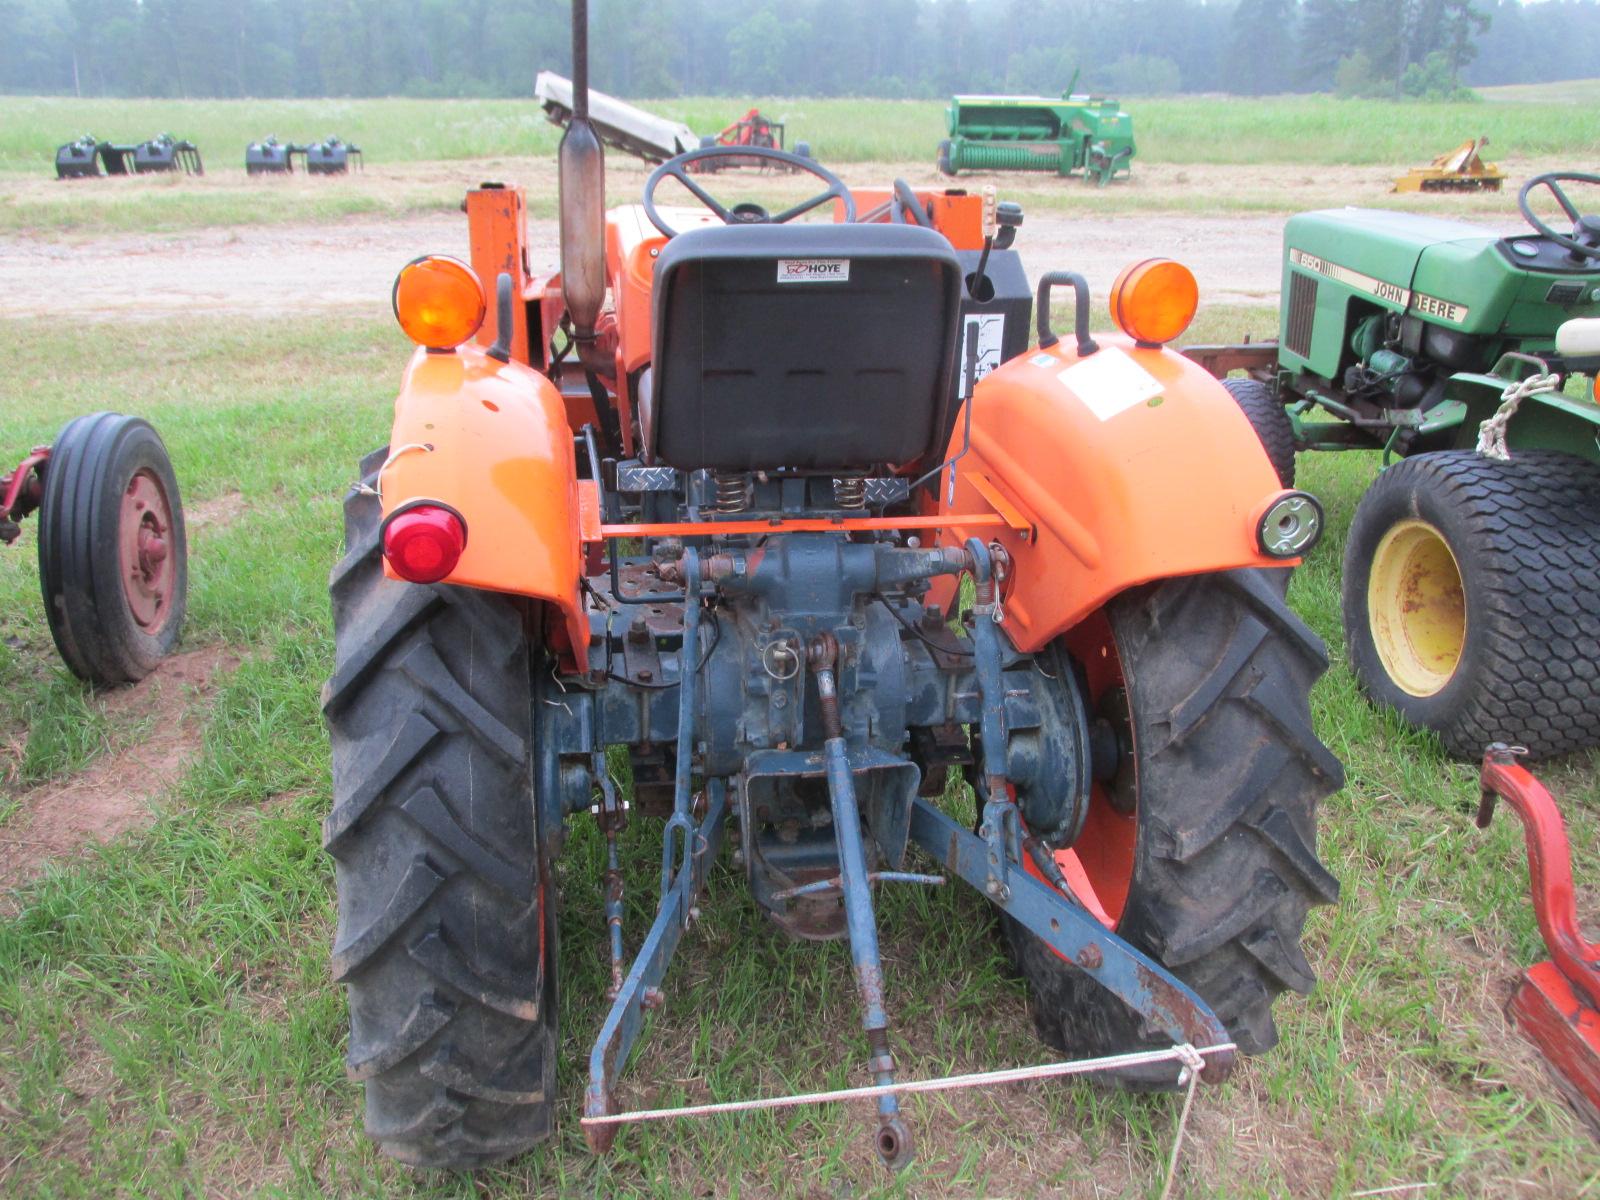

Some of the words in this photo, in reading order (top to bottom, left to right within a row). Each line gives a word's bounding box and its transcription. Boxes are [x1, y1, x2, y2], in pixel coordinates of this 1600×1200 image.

[808, 264, 841, 273] HOYE
[1301, 253, 1321, 271] 650
[1374, 281, 1403, 303] JOHN
